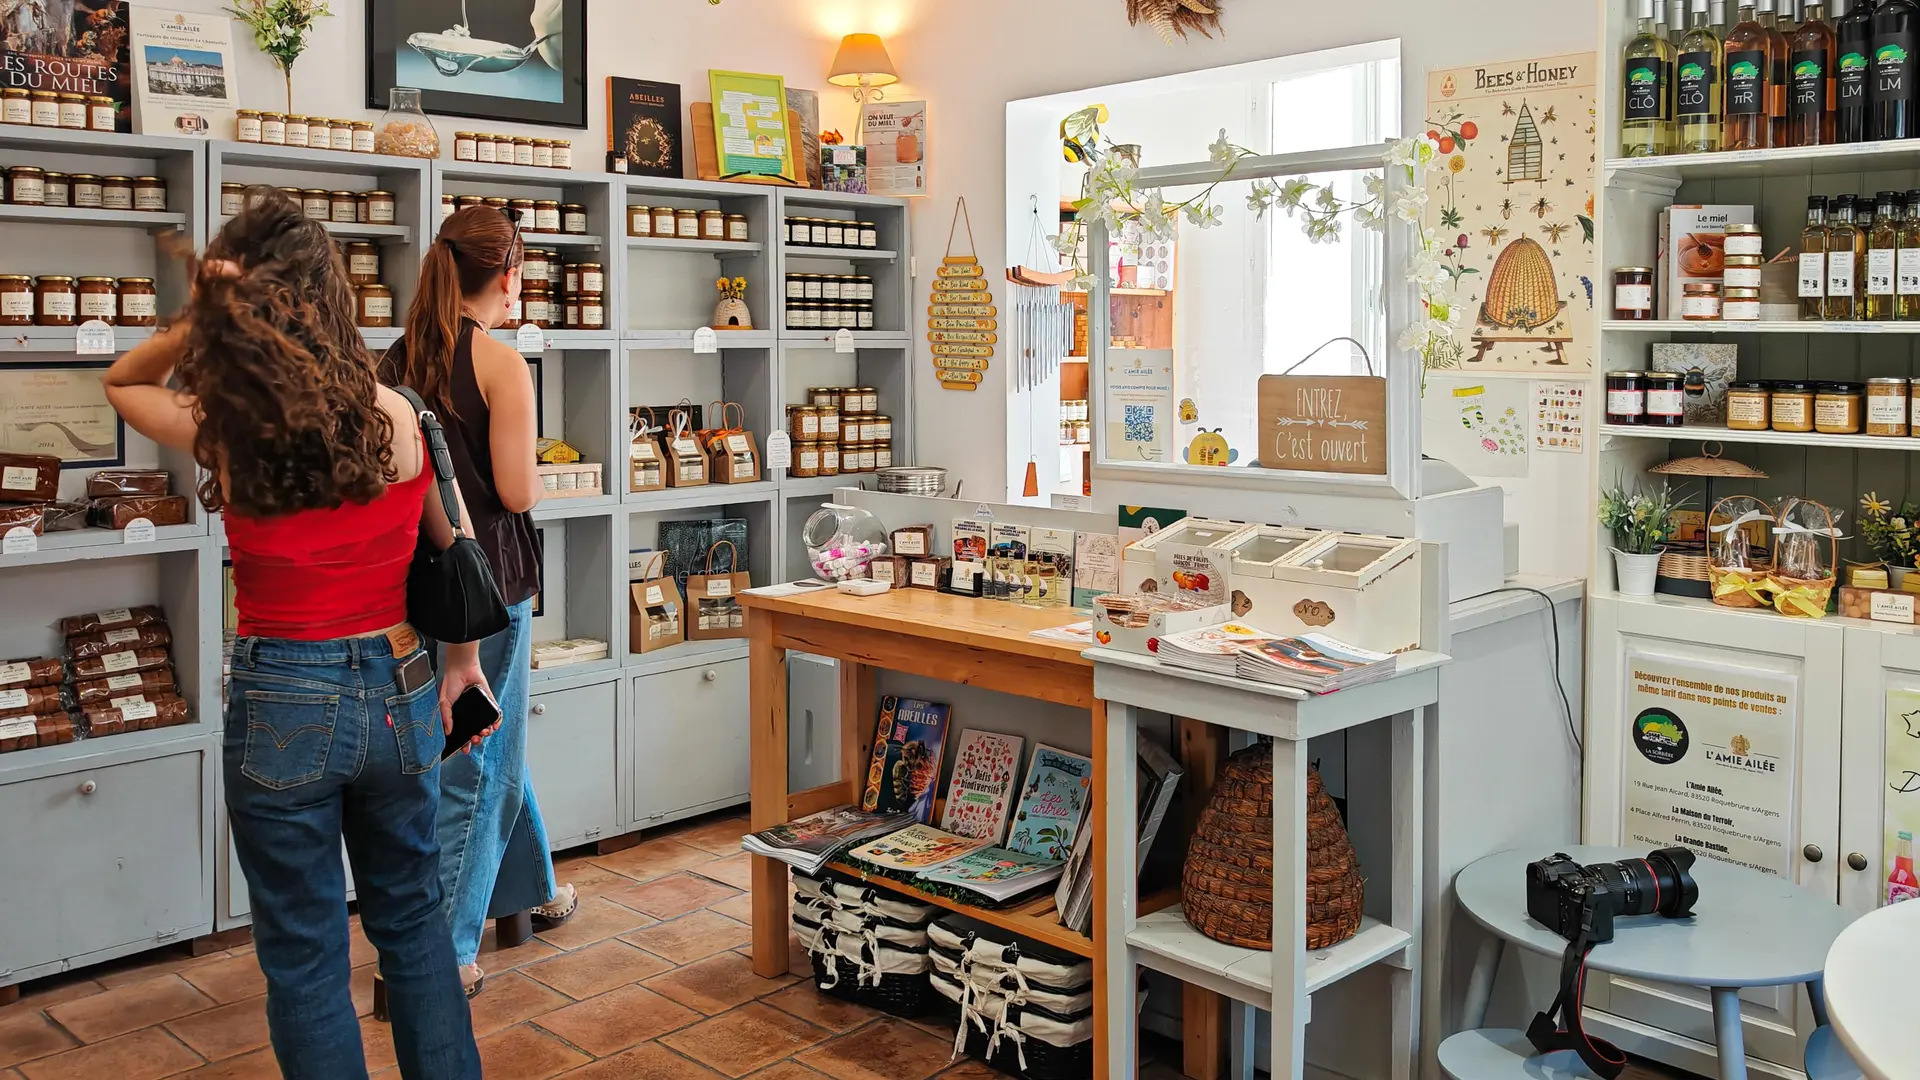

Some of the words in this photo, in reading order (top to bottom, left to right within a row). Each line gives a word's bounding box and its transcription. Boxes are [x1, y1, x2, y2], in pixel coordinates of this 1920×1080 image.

[0, 56, 24, 72] ES
[35, 59, 118, 82] ROUTES
[1474, 68, 1514, 90] BEES
[1516, 70, 1526, 82] &
[1528, 62, 1578, 84] HONEY
[10, 71, 42, 88] DU
[52, 76, 103, 94] MIEL
[1842, 84, 1862, 97] LM
[1880, 77, 1901, 90] LM
[630, 93, 664, 103] ABEILLES
[1629, 94, 1656, 109] CLÔ
[1679, 90, 1704, 105] CLÔ
[1697, 214, 1707, 222] Le
[1709, 214, 1728, 222] miel
[1296, 388, 1347, 422] ENTREZ,
[1276, 430, 1313, 460] C'est
[1321, 433, 1368, 463] ouvert
[1299, 604, 1323, 618] NO.
[1327, 609, 1335, 619] 3
[1634, 670, 1670, 685] Découvrez
[1672, 677, 1712, 692] l'ensemble
[1714, 684, 1724, 693] de
[1726, 687, 1739, 696] nos
[1742, 688, 1775, 702] produits
[1776, 694, 1787, 704] au
[1638, 684, 1660, 695] même
[1661, 687, 1676, 698] tarif
[1678, 690, 1696, 702] dans
[1697, 694, 1711, 704] nos
[1713, 697, 1737, 708] points
[1739, 700, 1748, 710] de
[1750, 703, 1777, 715] ventes
[898, 709, 938, 726] ABEILLES
[1706, 750, 1742, 766] L'AMIE
[1745, 757, 1775, 772] AILÉE
[975, 769, 991, 782] Défis
[961, 779, 1000, 795] biodiversité
[1686, 781, 1706, 792] L'Amie
[1040, 791, 1064, 803] Les
[1654, 784, 1668, 793] Jean
[1669, 786, 1689, 798] Aicard,
[1691, 792, 1710, 802] 83520
[1711, 797, 1750, 811] Roquebrune
[1751, 806, 1780, 818] s/Argens
[1031, 802, 1069, 816] arbres
[1672, 805, 1679, 814] La
[1680, 807, 1702, 819] Maison
[1703, 812, 1711, 821] du
[1635, 808, 1651, 817] Place
[1652, 811, 1670, 821] Alfred
[1671, 815, 1691, 827] Perrin,
[1692, 820, 1712, 831] 83520
[1713, 825, 1751, 840] Roquebrune
[1753, 834, 1782, 847] s/Argens
[1633, 834, 1644, 842] 160
[1645, 836, 1662, 847] Route
[1664, 840, 1671, 848] du
[1675, 834, 1682, 842] La
[1683, 836, 1704, 848] Grande
[1708, 852, 1747, 868] Roquebrune
[1749, 862, 1777, 875] s/Argens
